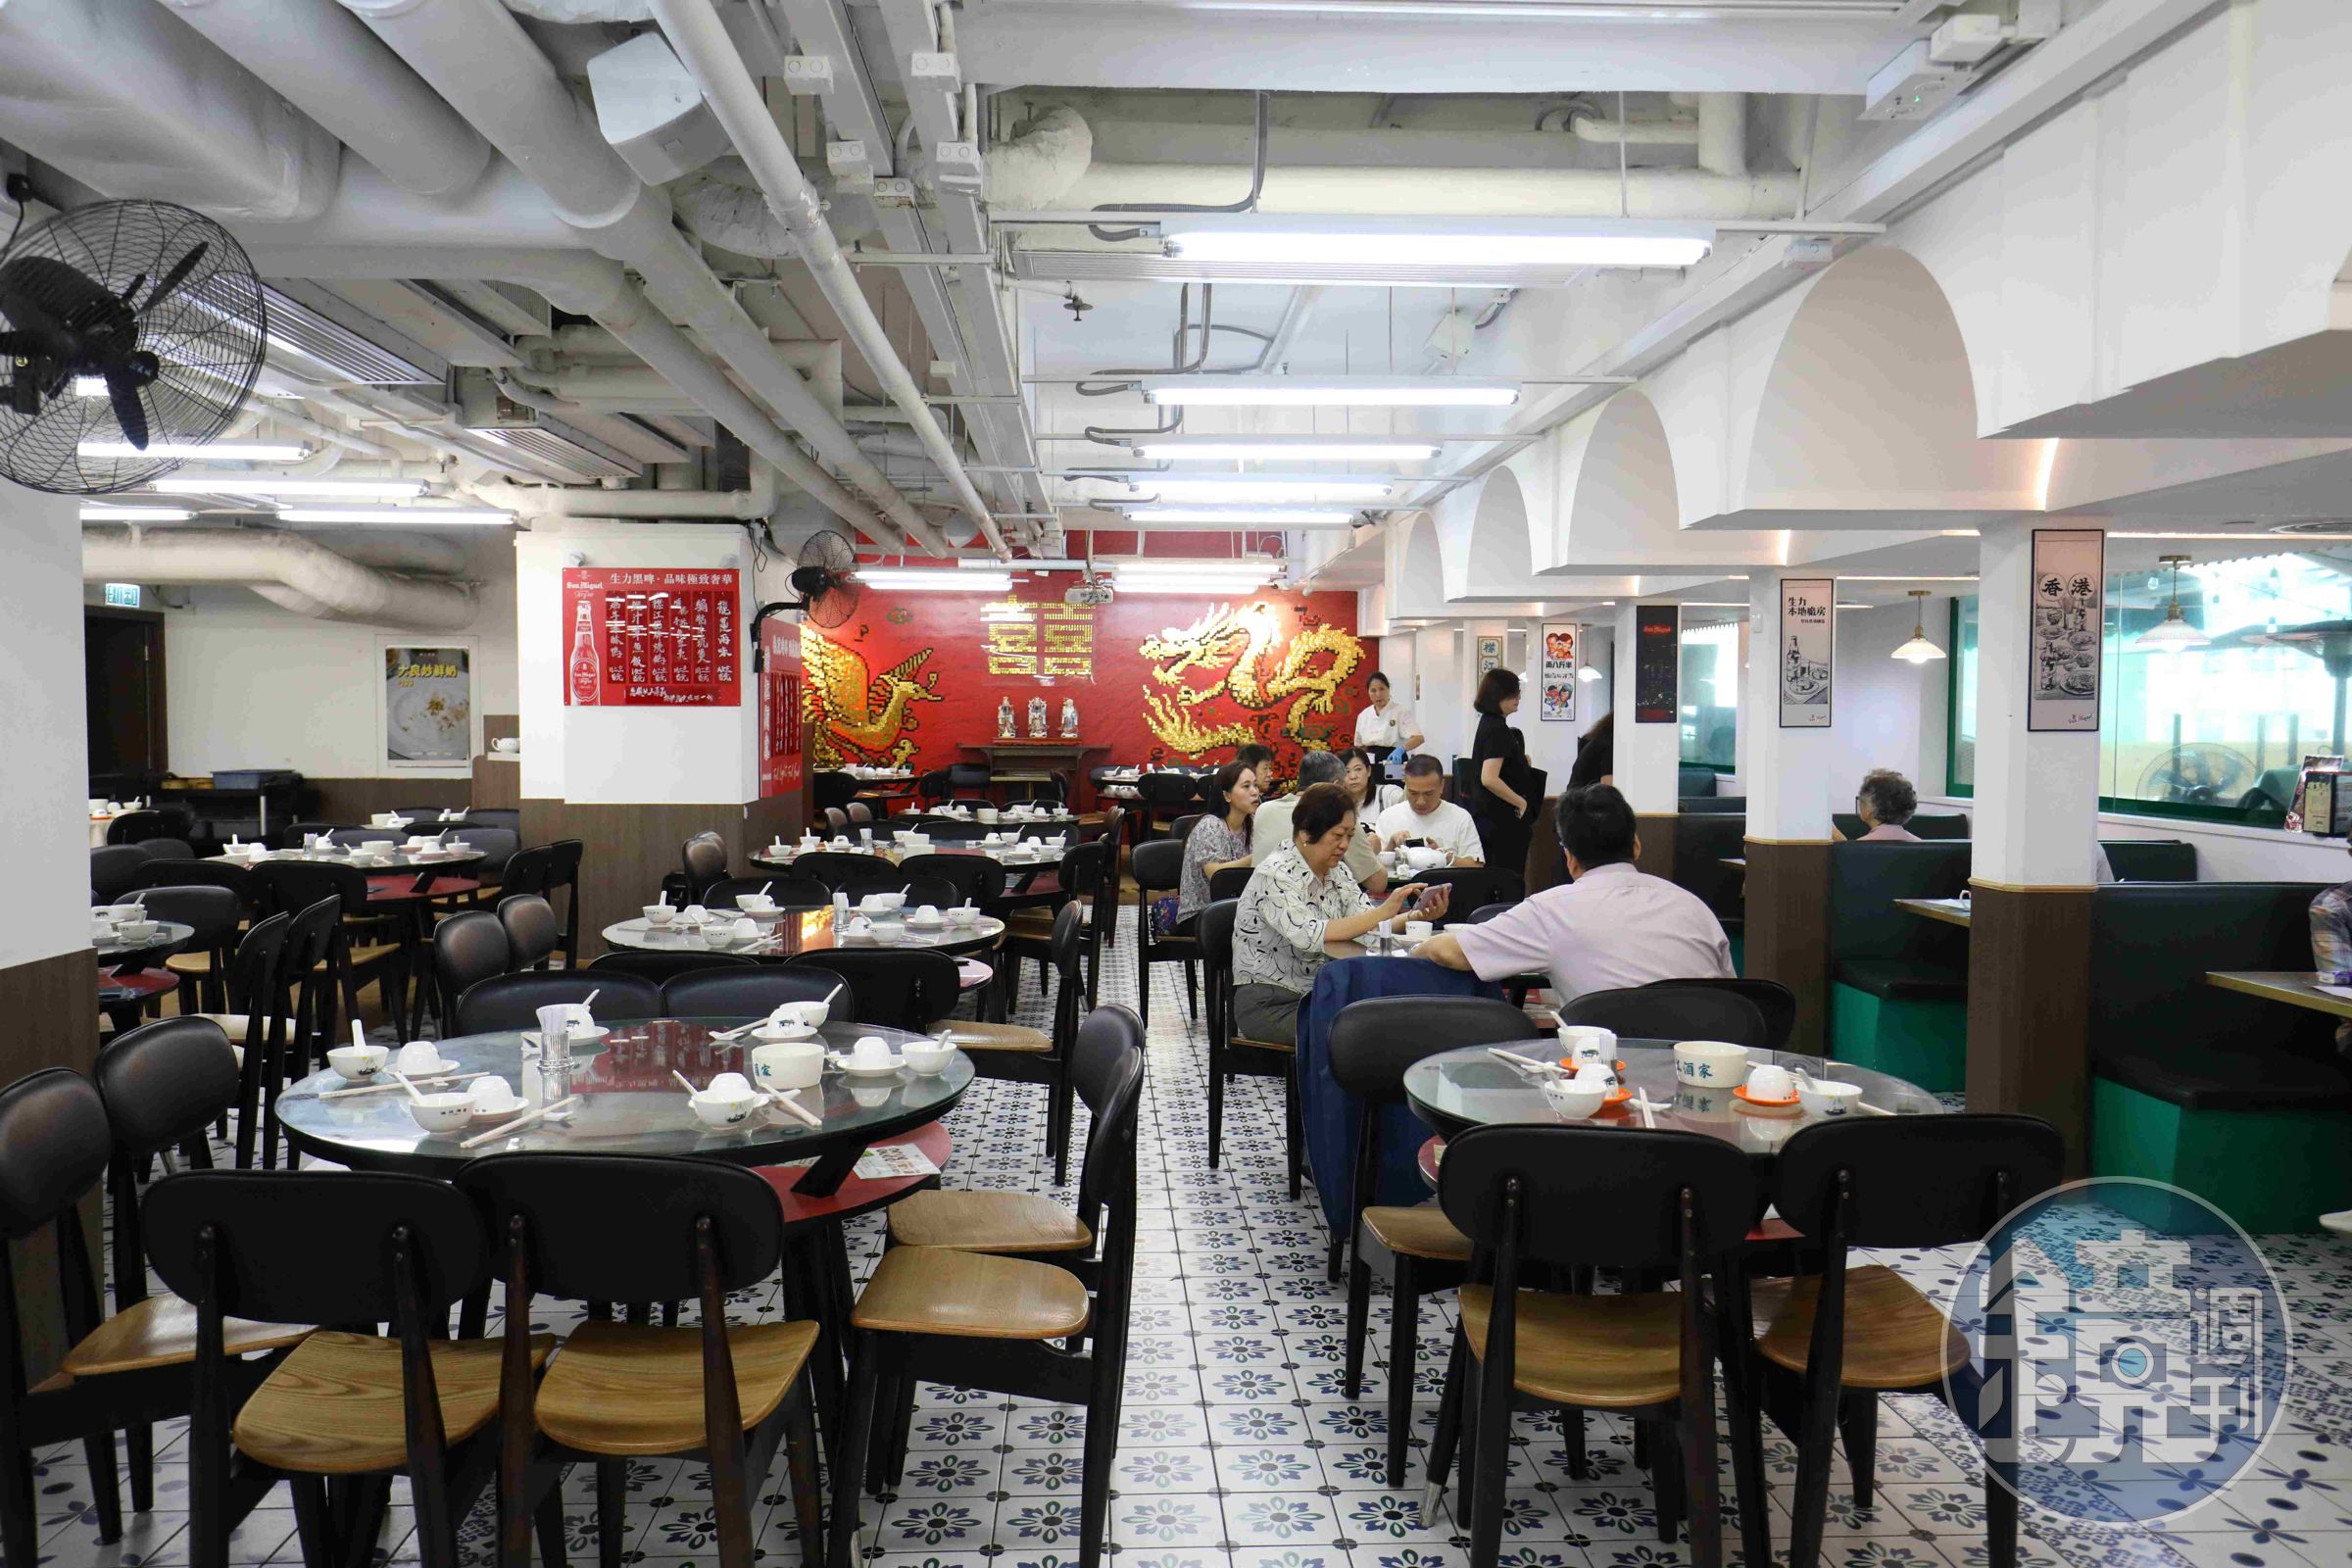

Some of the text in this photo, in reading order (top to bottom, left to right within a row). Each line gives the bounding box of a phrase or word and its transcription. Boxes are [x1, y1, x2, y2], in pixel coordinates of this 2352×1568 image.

[2042, 577, 2092, 597] 香港
[1788, 596, 1806, 607] 生力
[397, 663, 459, 678] 大良炒鮮奶
